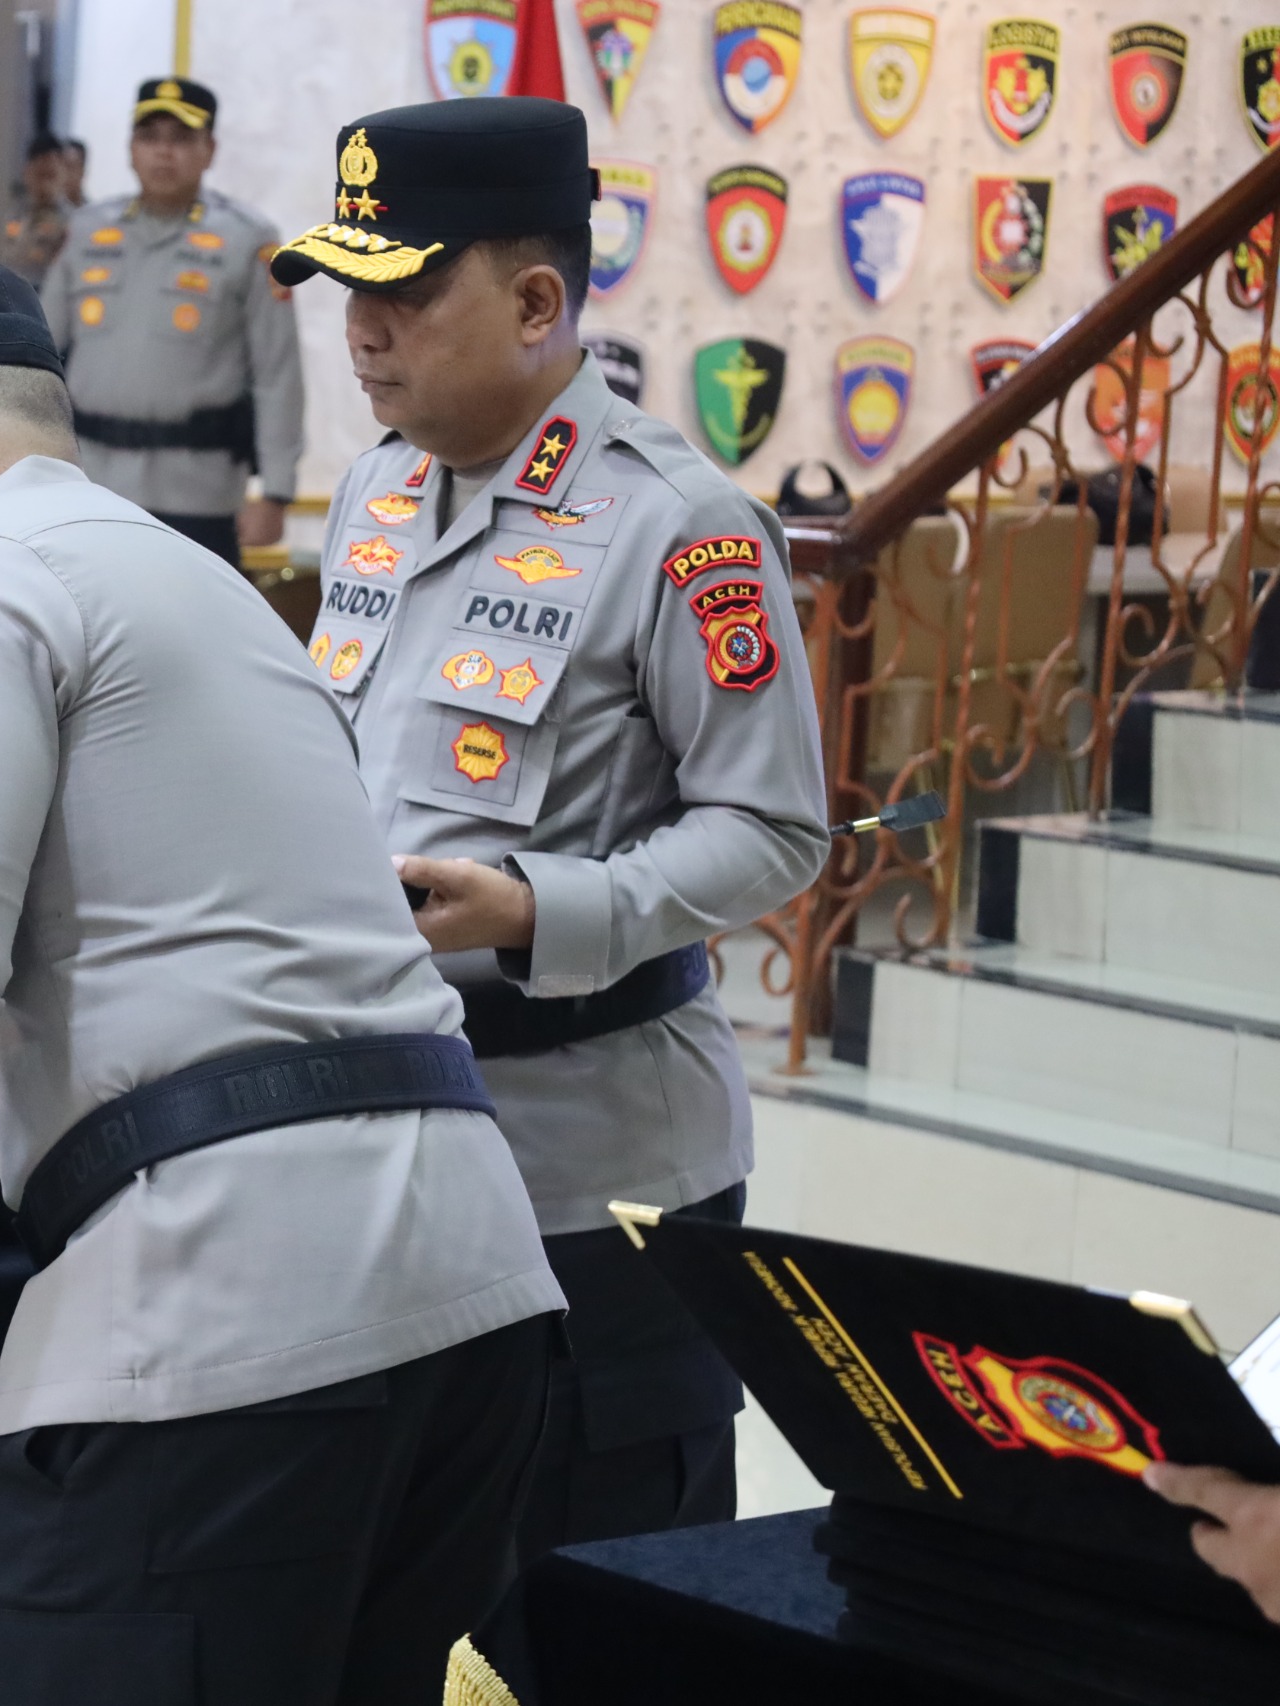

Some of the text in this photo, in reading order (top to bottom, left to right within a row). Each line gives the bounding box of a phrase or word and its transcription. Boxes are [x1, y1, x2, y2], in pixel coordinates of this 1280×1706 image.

[672, 540, 754, 579] POLDA
[326, 581, 397, 621] RUDDI
[702, 585, 750, 608] ACEH
[464, 595, 573, 641] POLRI
[463, 743, 497, 760] RESERSE
[225, 1054, 350, 1114] POLRI
[926, 1348, 1004, 1434] ACEH
